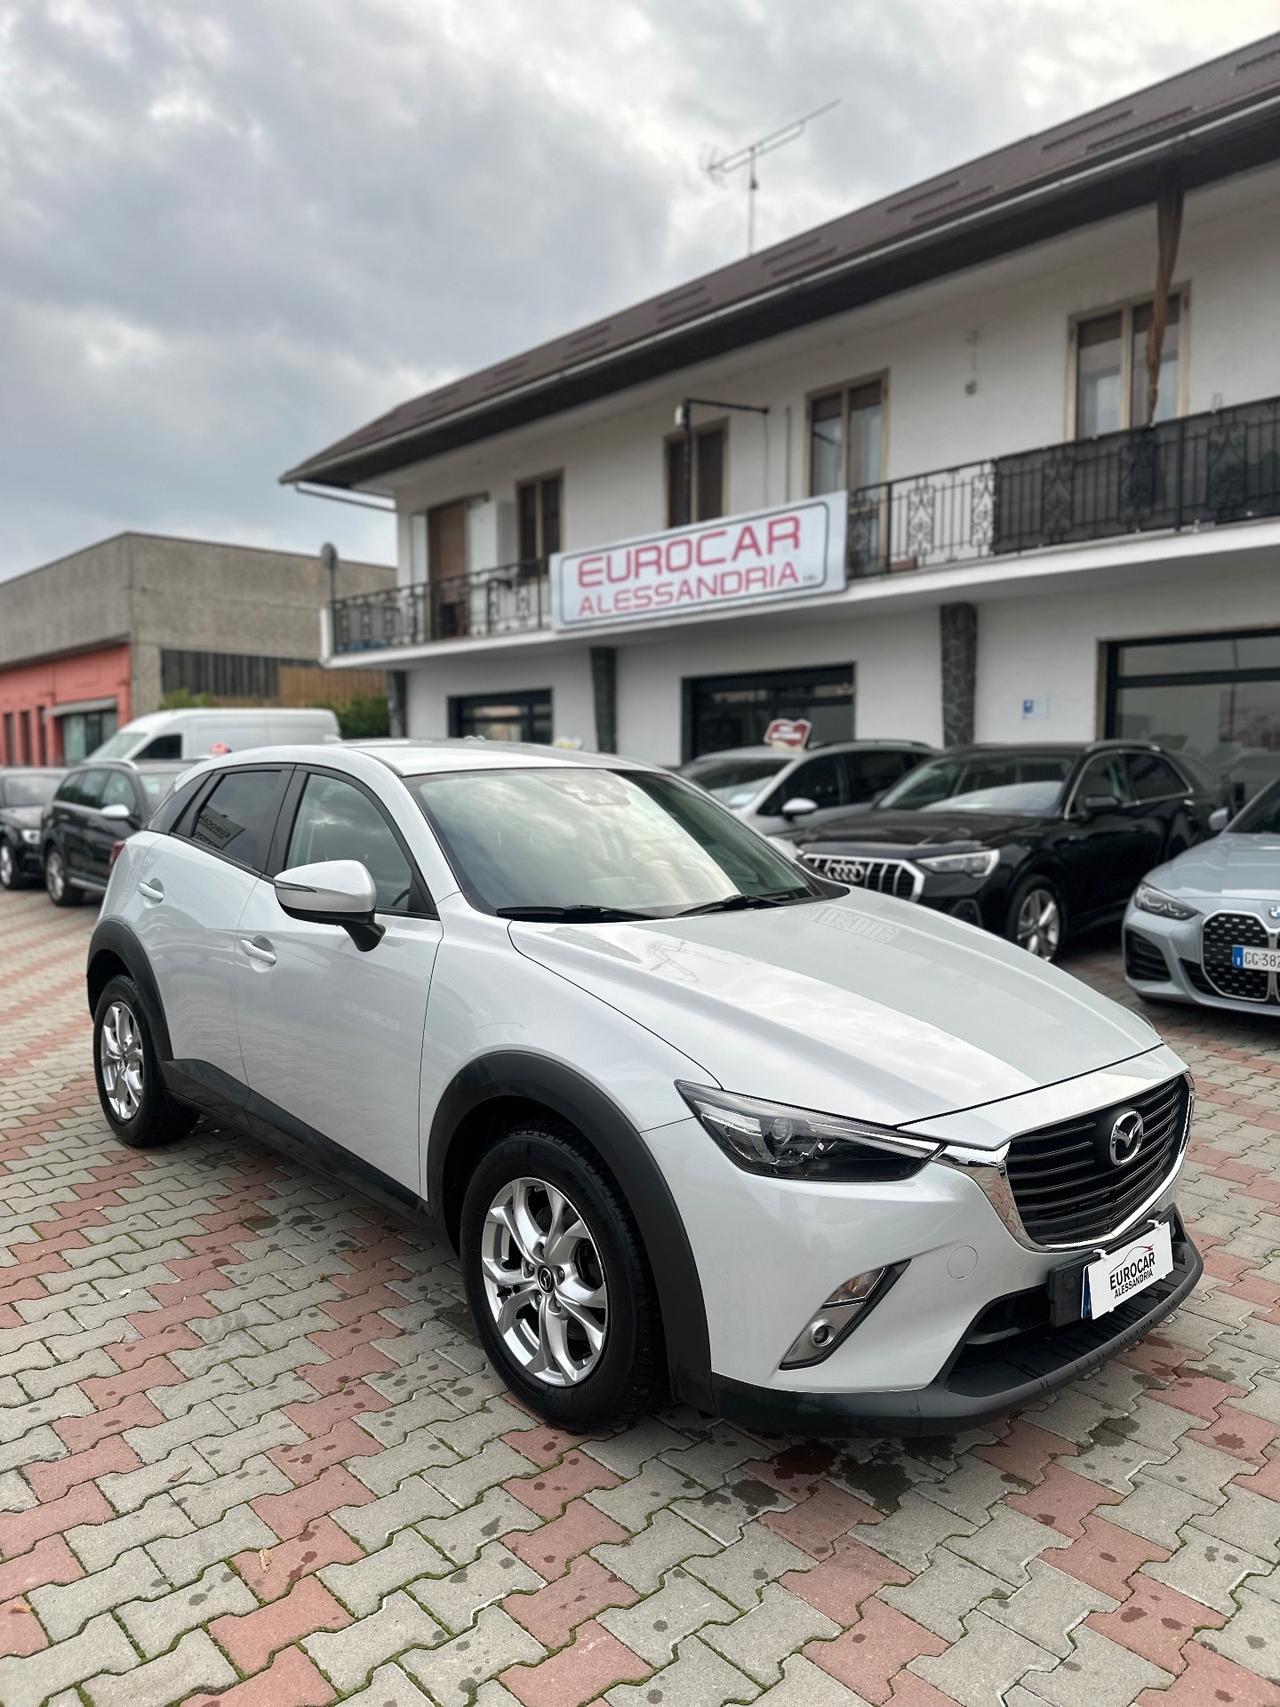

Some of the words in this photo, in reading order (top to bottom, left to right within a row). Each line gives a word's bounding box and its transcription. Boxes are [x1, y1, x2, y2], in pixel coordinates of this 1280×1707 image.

[578, 515, 801, 588] EUROCAR
[578, 561, 799, 616] ALESSANDRIA
[1110, 1251, 1155, 1290] EUROCAR
[1114, 1268, 1153, 1299] ALESSANDRIA
